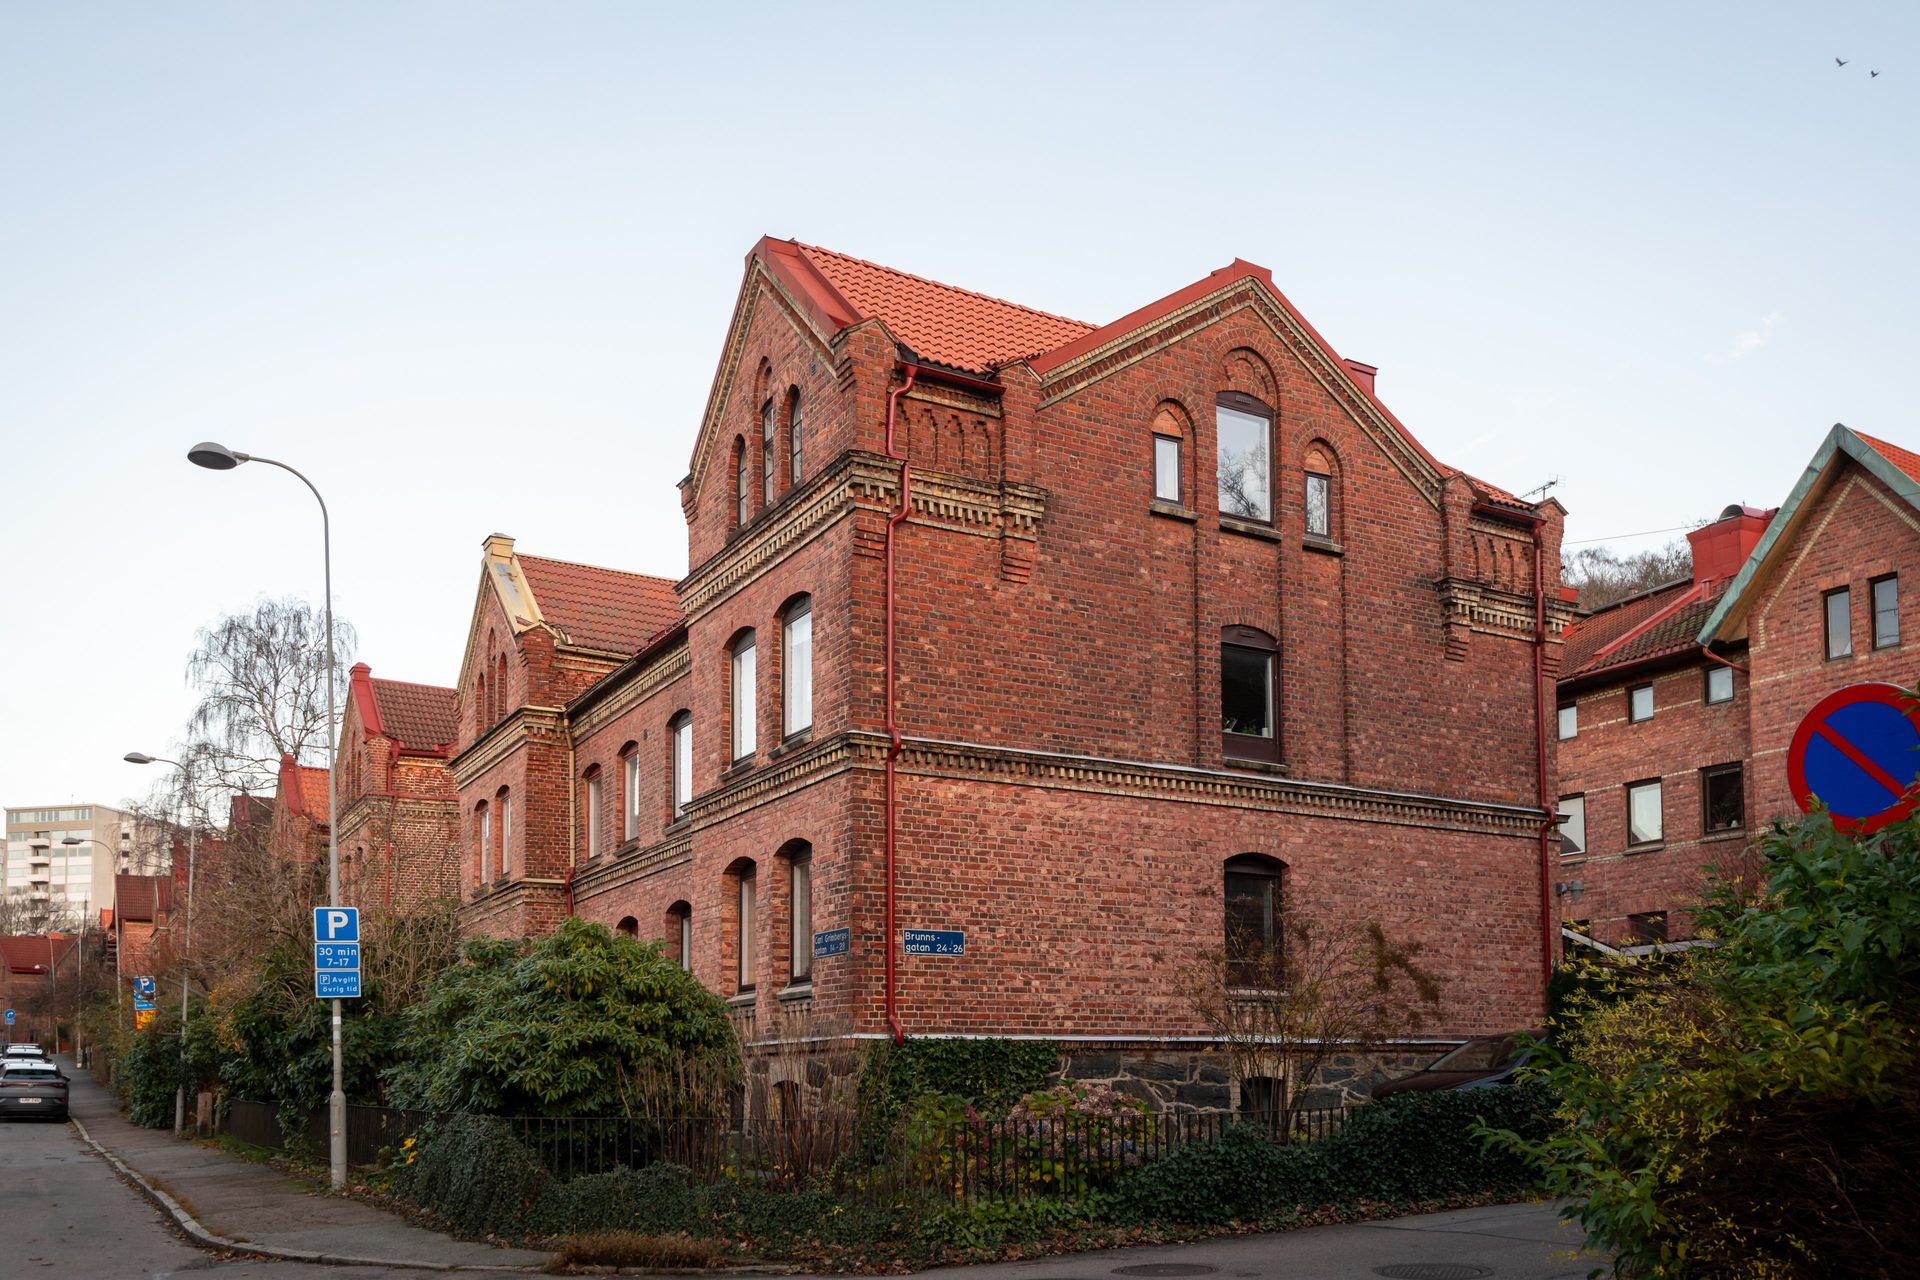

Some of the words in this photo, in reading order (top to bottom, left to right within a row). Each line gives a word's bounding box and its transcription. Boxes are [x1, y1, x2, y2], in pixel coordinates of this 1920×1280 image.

[328, 911, 349, 939] P
[905, 931, 940, 941] Brunns-
[319, 947, 333, 956] 30
[337, 947, 357, 956] min
[905, 943, 931, 953] gatan
[326, 958, 349, 967] 7-17
[140, 978, 150, 990] P
[332, 976, 357, 984] Avgift
[322, 985, 344, 993] övrig
